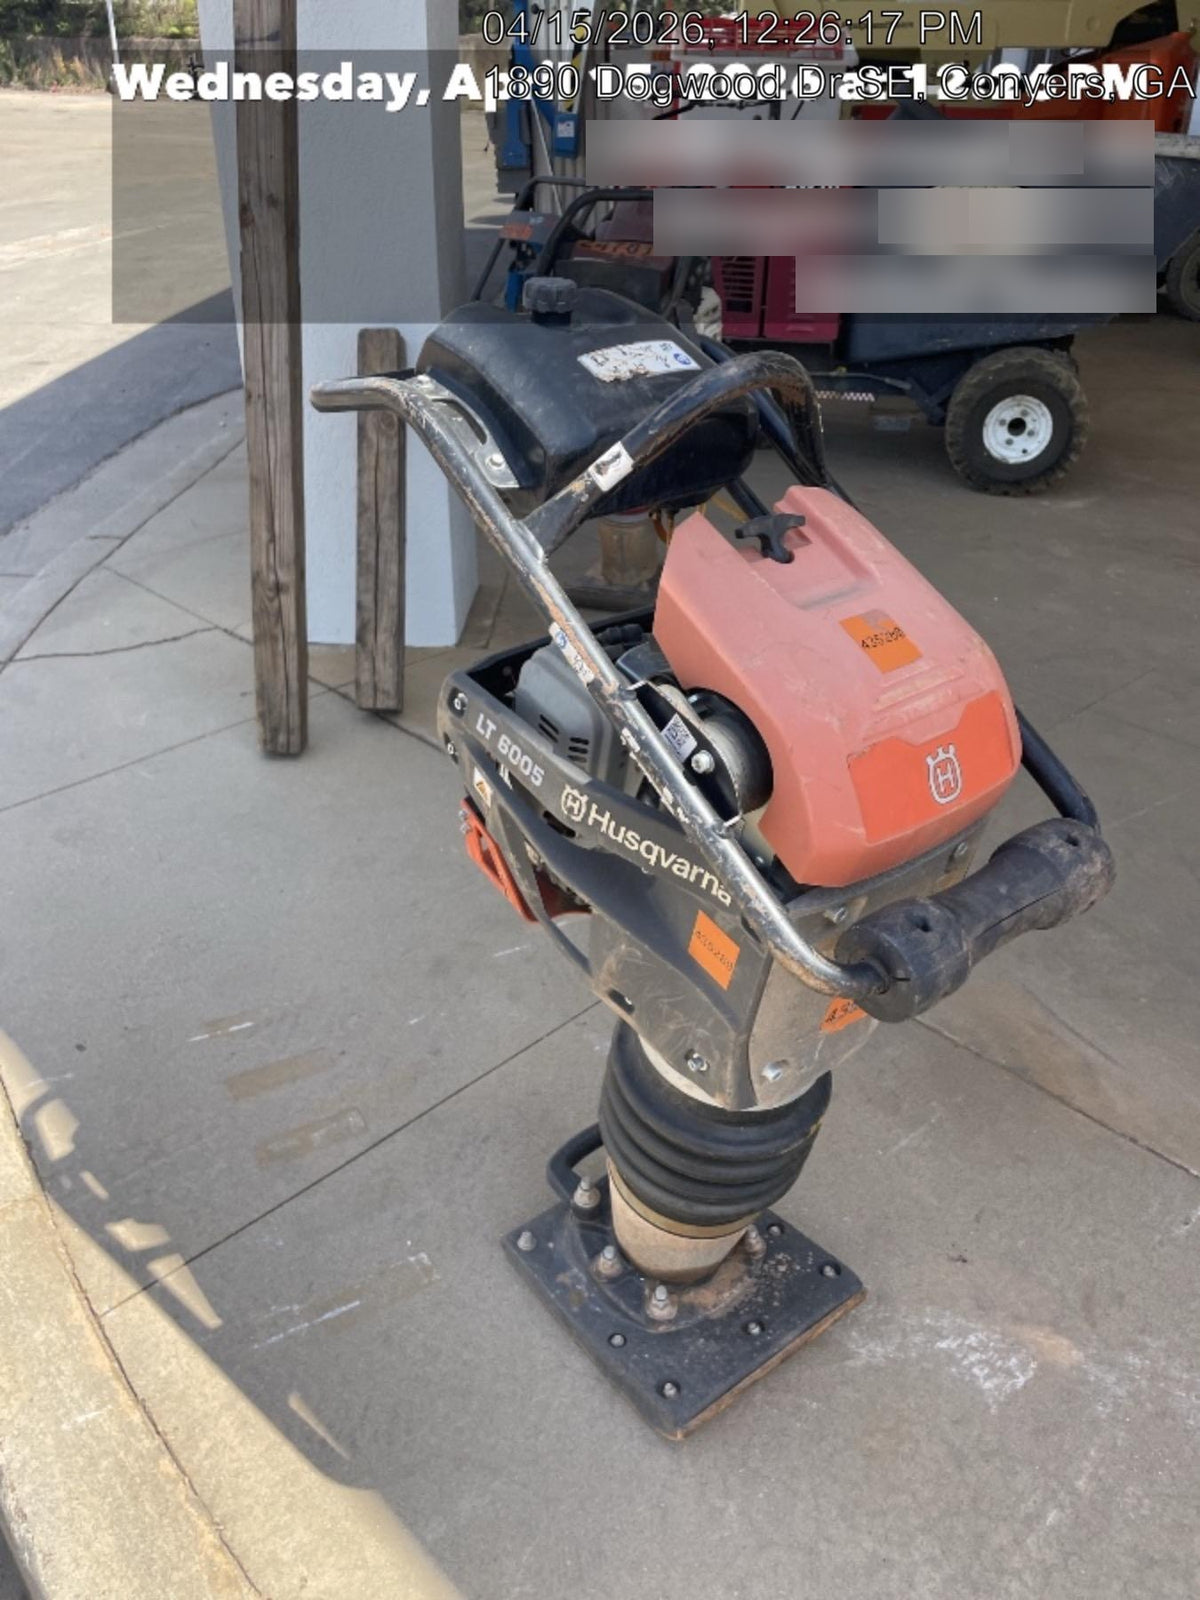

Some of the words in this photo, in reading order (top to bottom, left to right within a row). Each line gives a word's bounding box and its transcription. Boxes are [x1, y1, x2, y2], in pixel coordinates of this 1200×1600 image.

[475, 712, 498, 741] LT
[499, 734, 545, 787] 6005
[587, 803, 732, 907] Husqvarna
